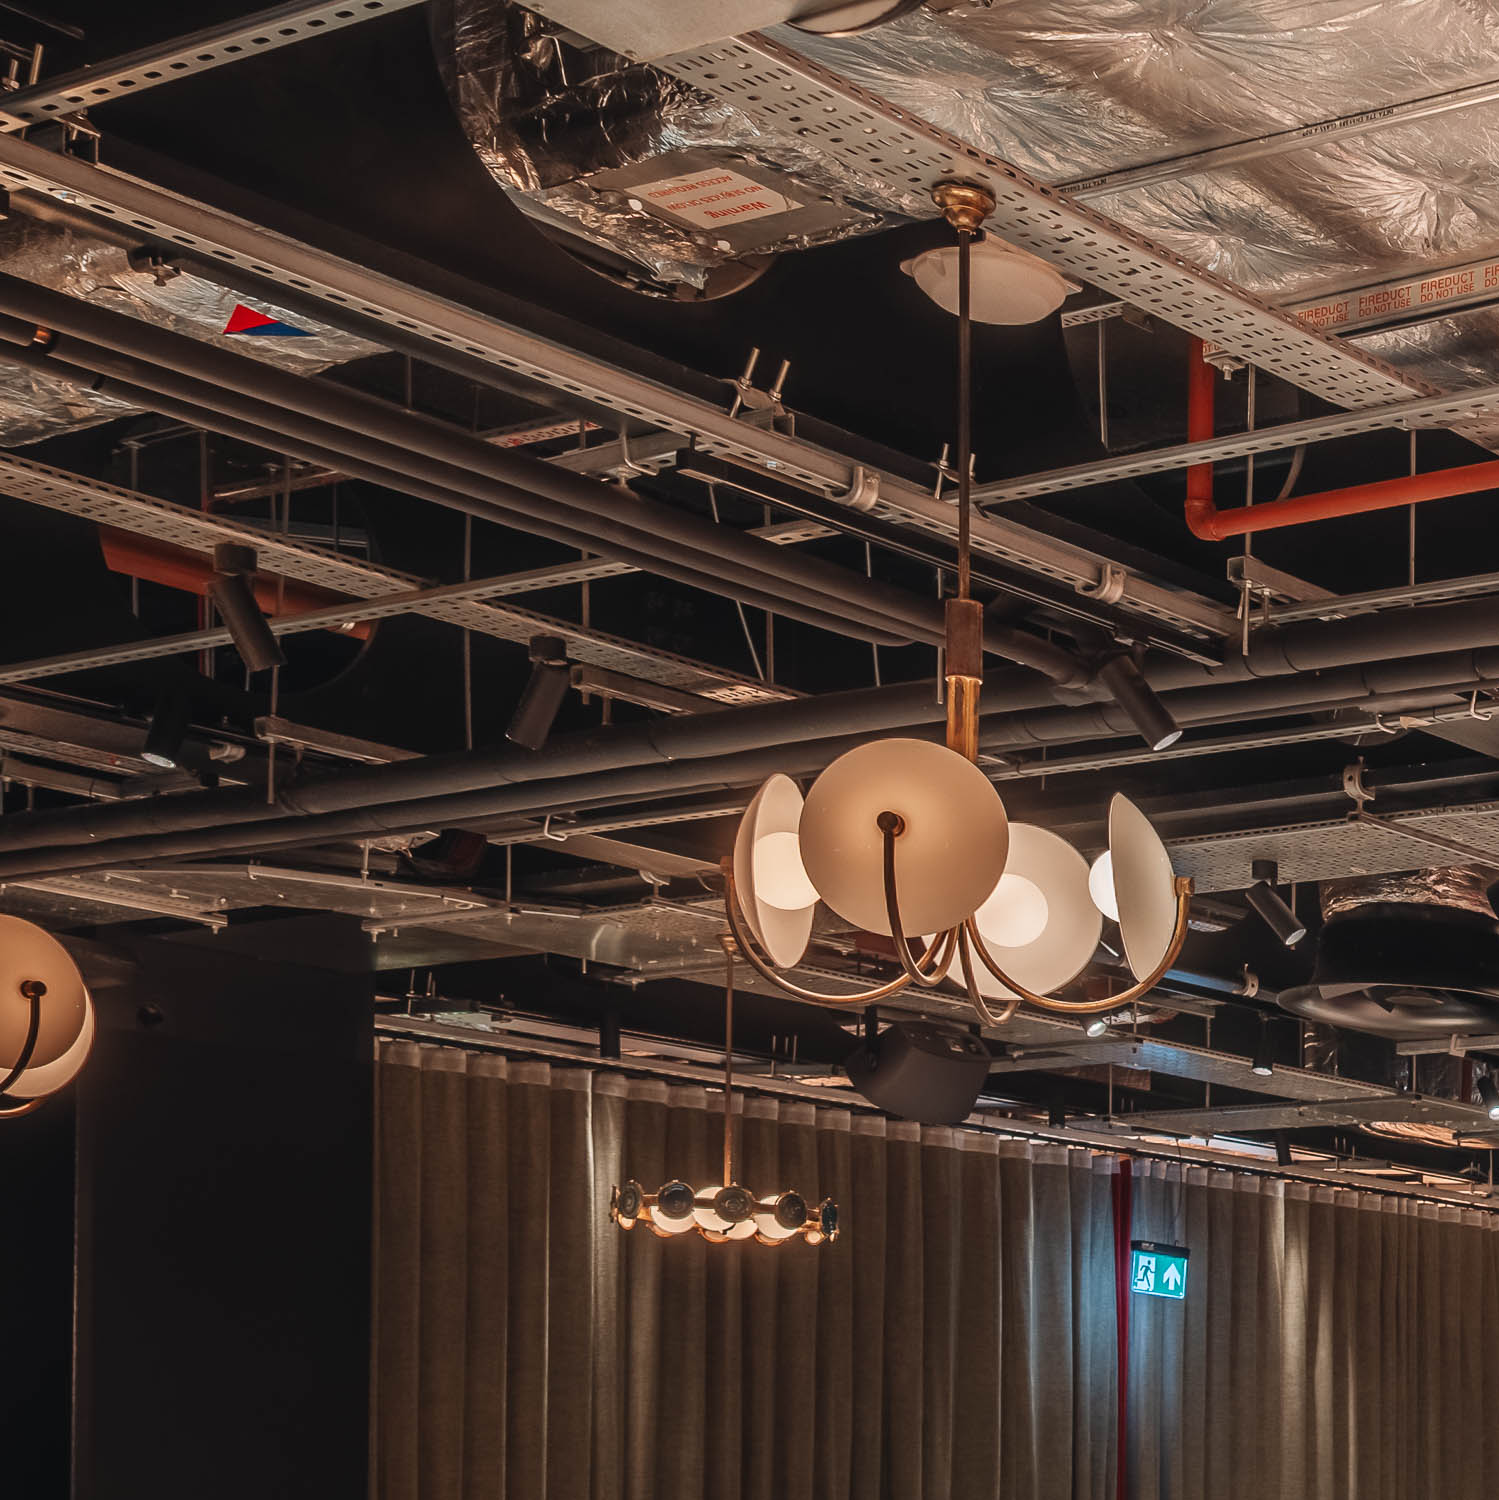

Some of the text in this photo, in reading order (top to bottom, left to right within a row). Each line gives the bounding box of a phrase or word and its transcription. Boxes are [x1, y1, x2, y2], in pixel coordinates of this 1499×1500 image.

[704, 201, 771, 219] Warning
[1420, 271, 1474, 293] FIREDUCT
[1484, 276, 1498, 288] DO
[1359, 286, 1412, 307] FIREDUCT
[1420, 284, 1474, 302] DO NOT USE
[1359, 298, 1412, 318] DO NOT USE
